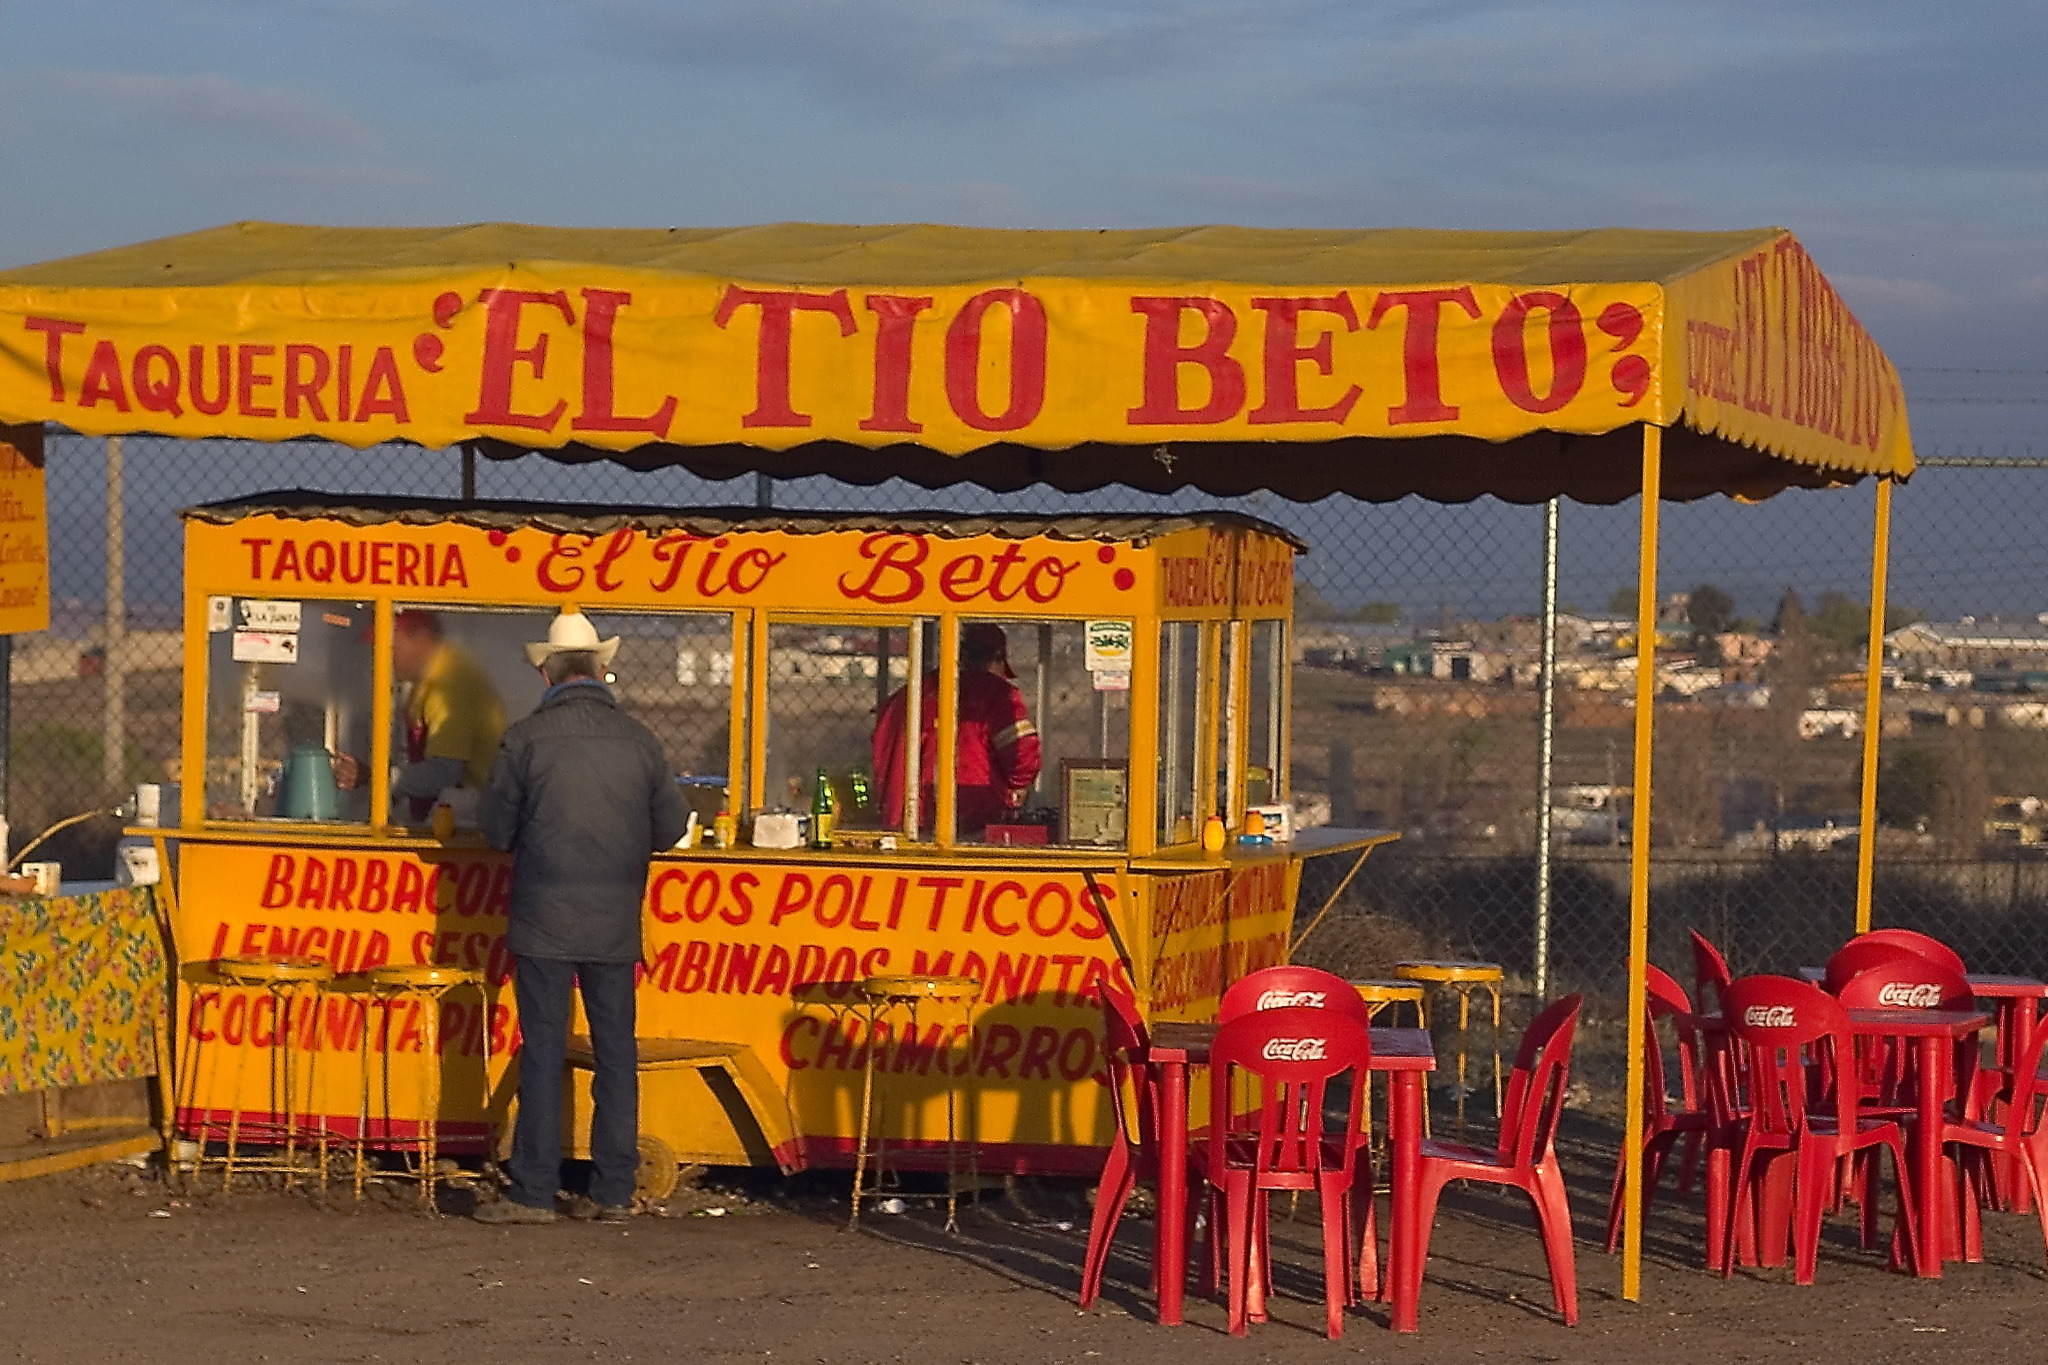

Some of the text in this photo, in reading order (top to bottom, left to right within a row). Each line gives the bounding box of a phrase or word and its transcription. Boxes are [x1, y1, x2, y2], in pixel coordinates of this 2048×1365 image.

[25, 315, 410, 424] TAQUERIA
[463, 286, 679, 439] EL
[714, 283, 1048, 434] TIO
[1126, 285, 1587, 427] BETO
[241, 527, 1081, 604] TAQUERIA El Tio Beto
[650, 868, 760, 926] COS
[770, 872, 1116, 940] POLITICOS
